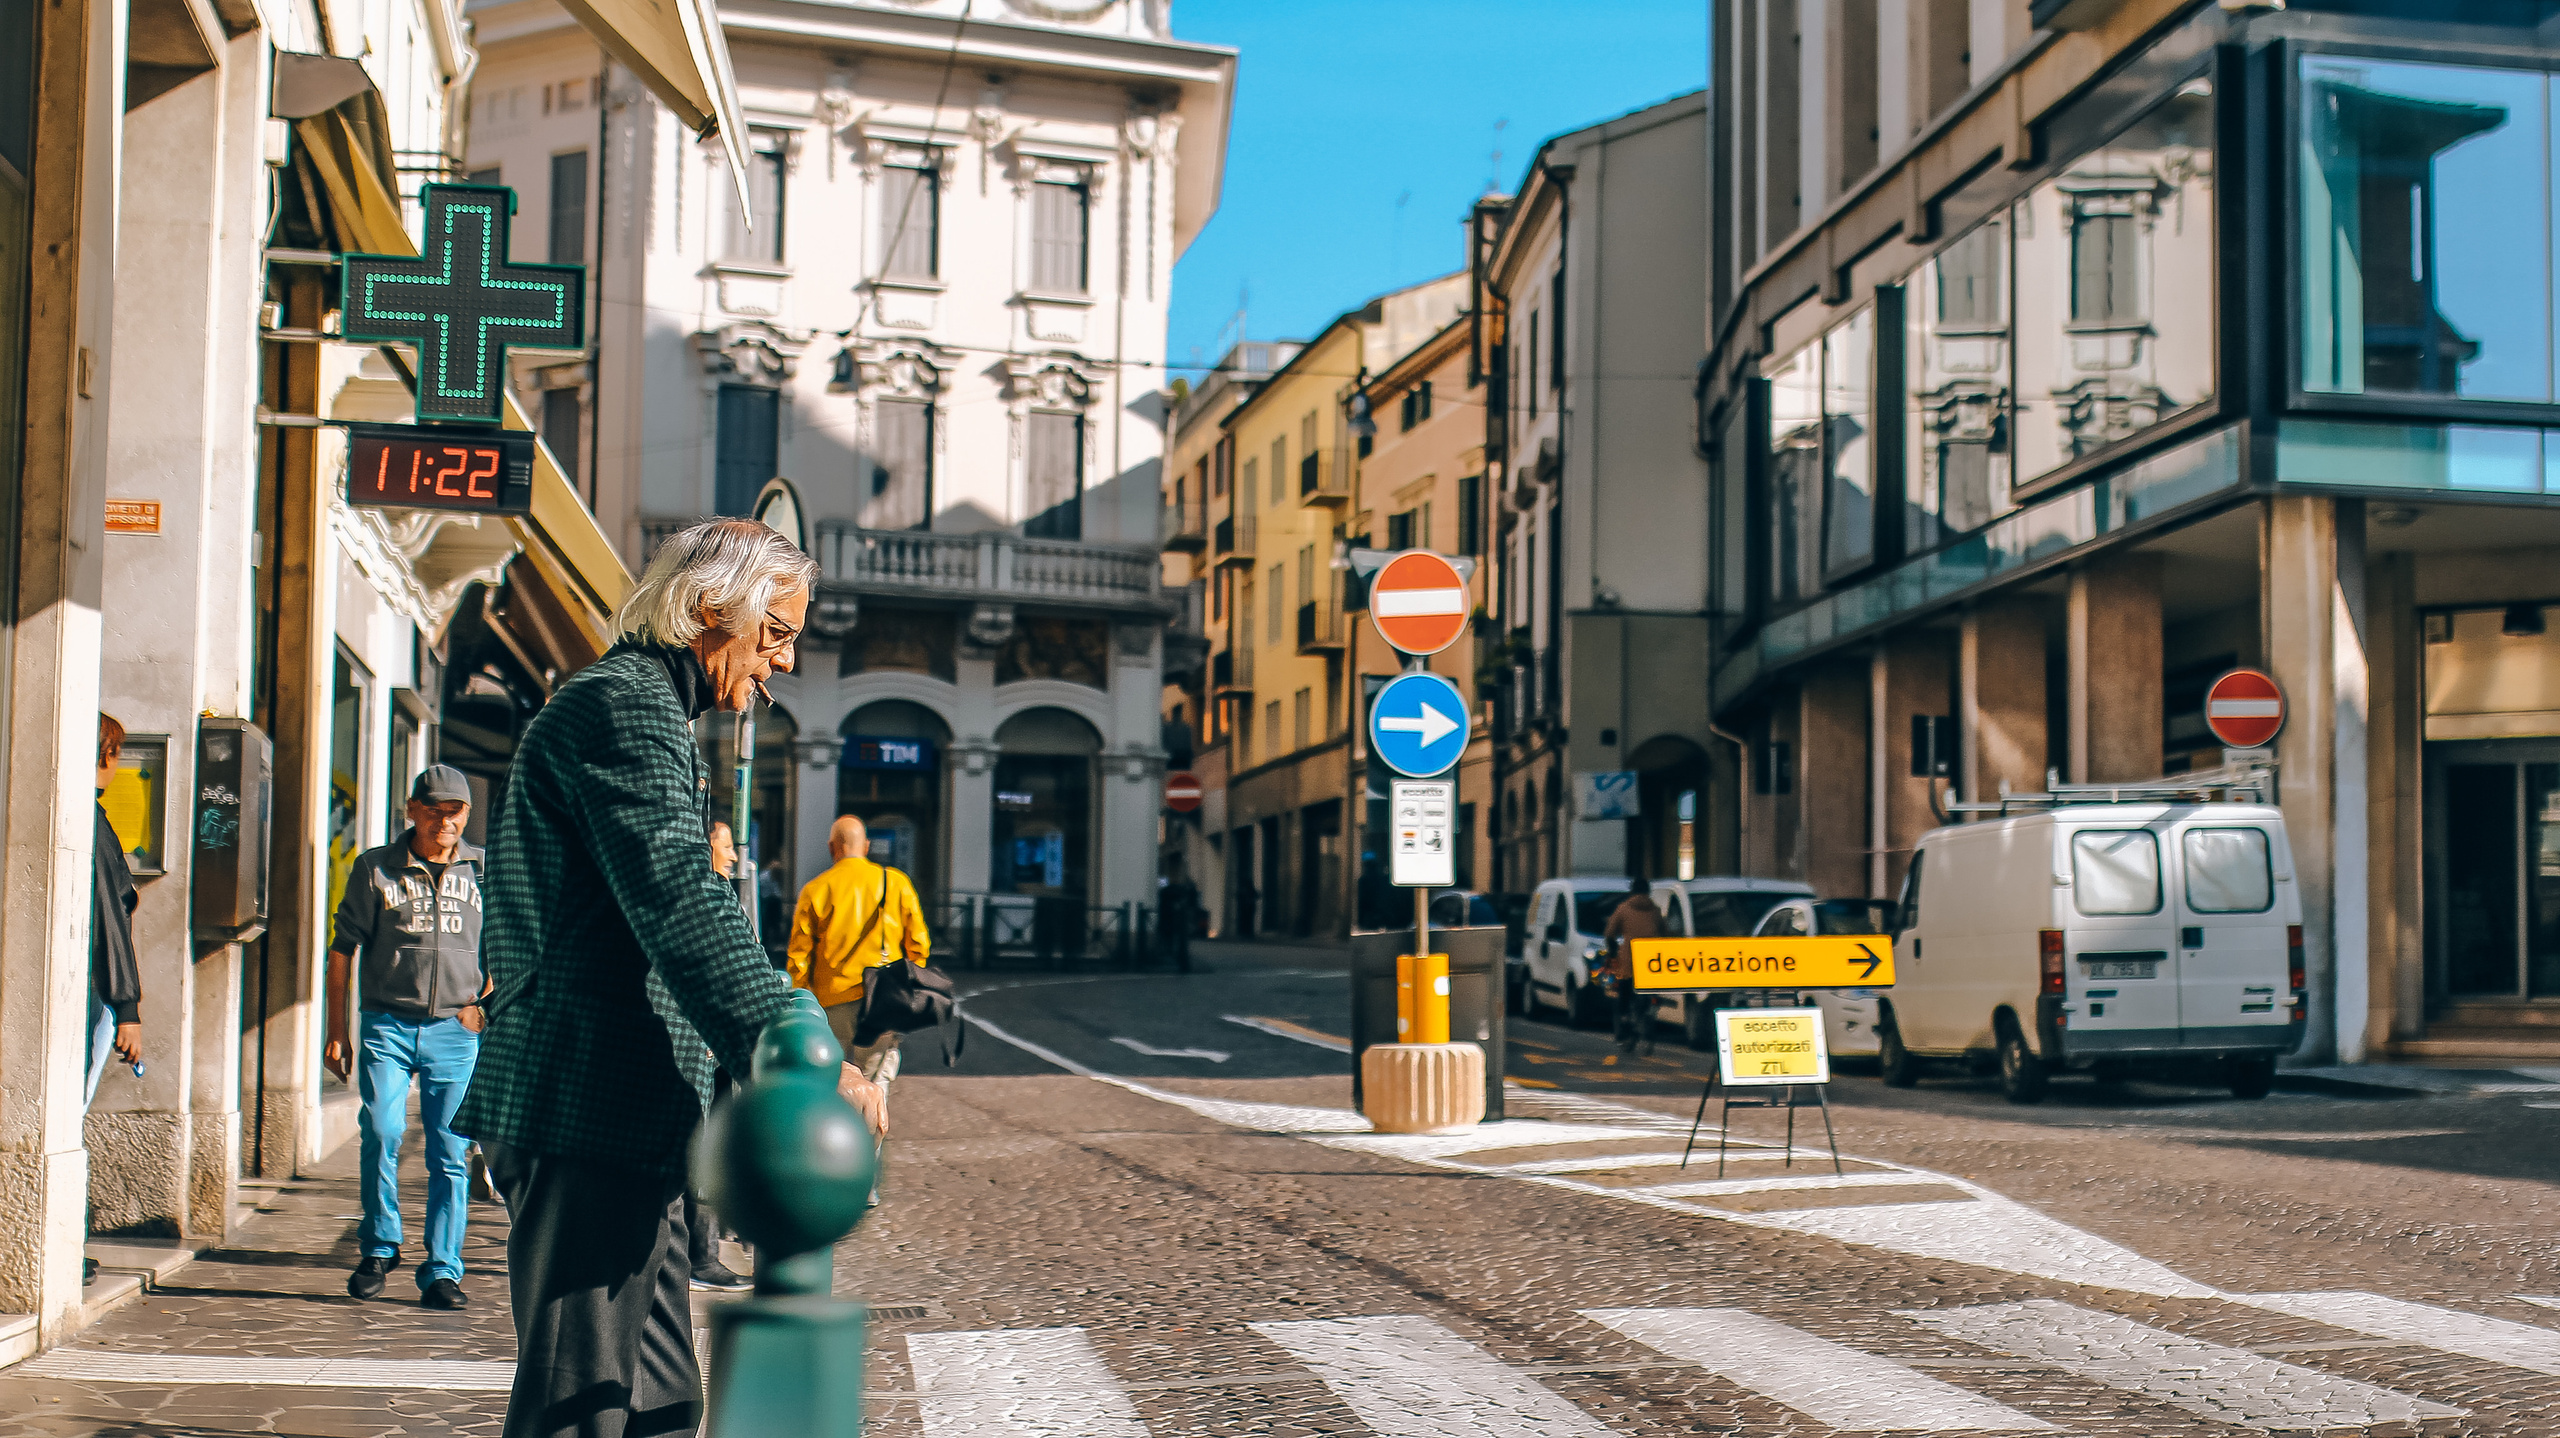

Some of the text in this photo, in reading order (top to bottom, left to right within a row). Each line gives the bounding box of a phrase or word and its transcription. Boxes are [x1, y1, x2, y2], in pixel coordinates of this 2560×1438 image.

[377, 446, 500, 499] 11:22
[879, 742, 918, 763] TIM
[1647, 951, 1796, 973] deviazione
[1744, 1020, 1797, 1033] eccetto
[1734, 1040, 1810, 1054] autorizzati
[1760, 1061, 1790, 1075] ZTL
